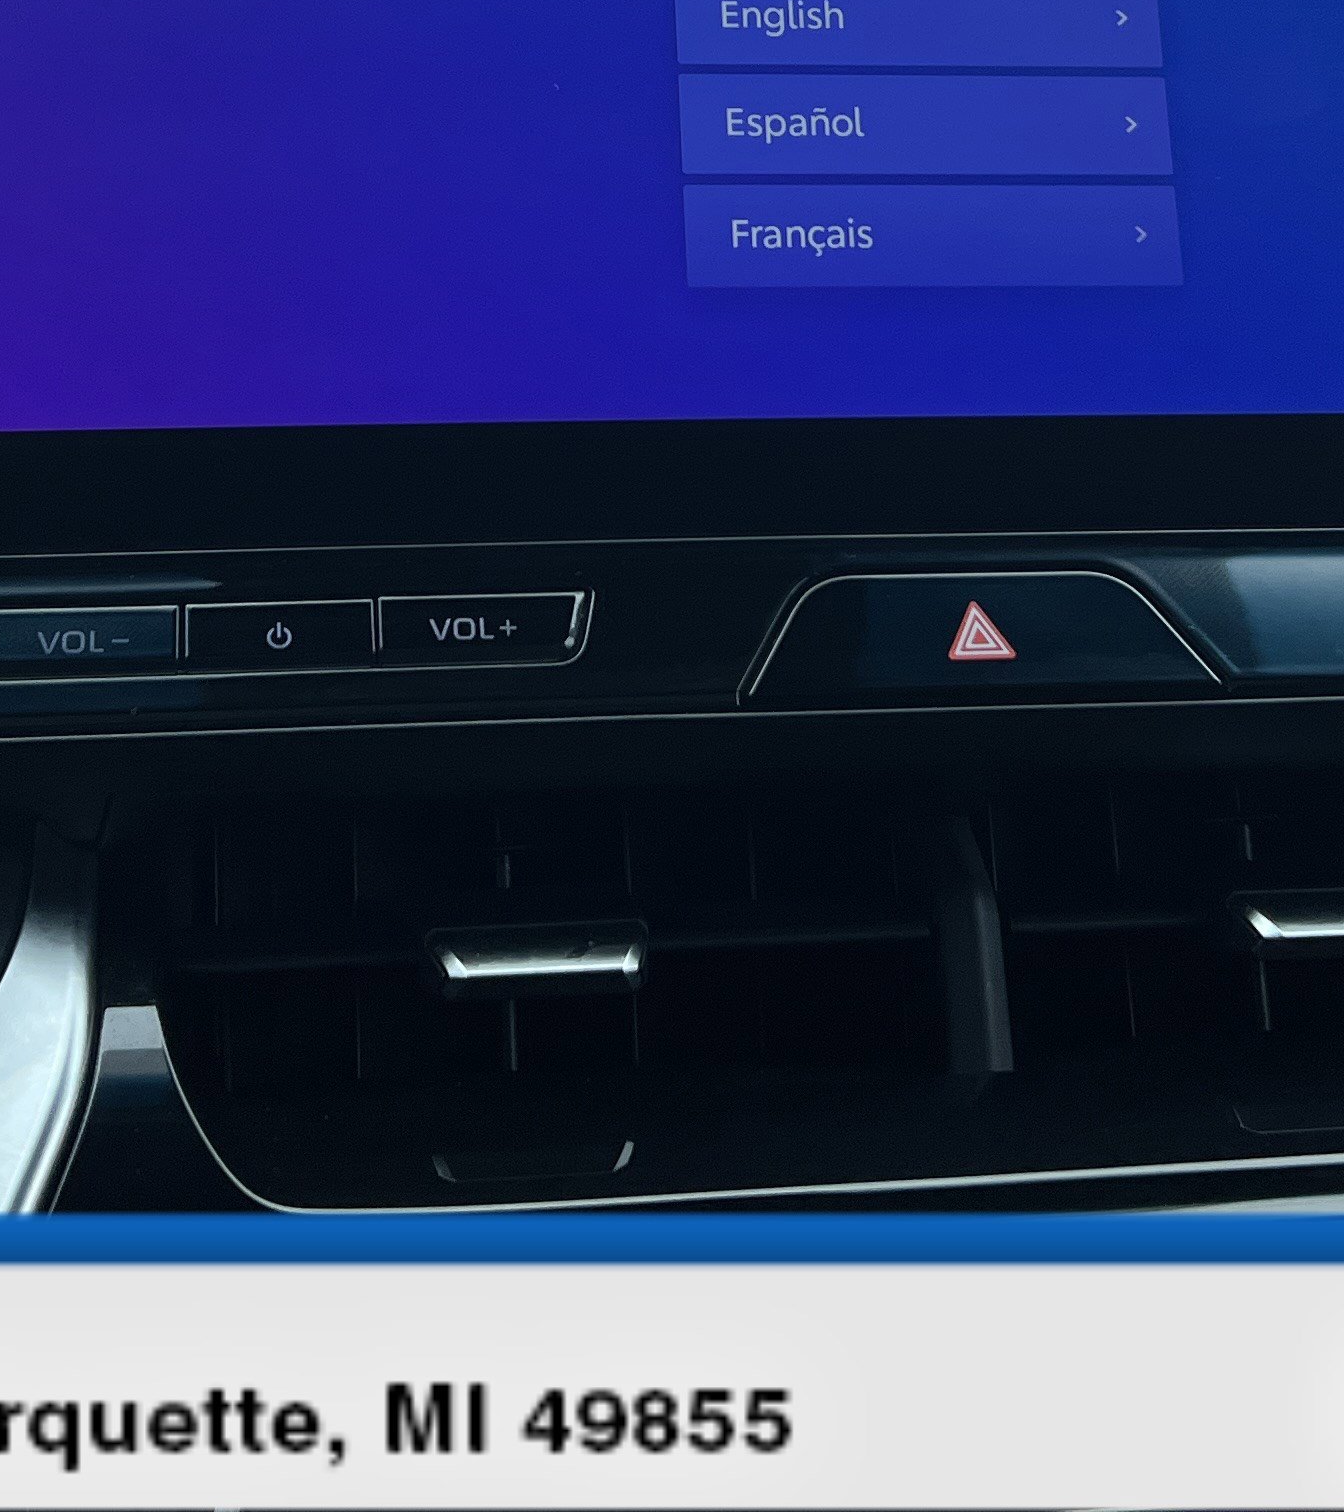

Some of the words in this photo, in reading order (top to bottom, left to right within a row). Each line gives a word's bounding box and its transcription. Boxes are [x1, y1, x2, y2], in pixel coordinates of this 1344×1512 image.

[720, 0, 846, 37] English
[725, 107, 865, 144] Español
[731, 217, 874, 257] Français
